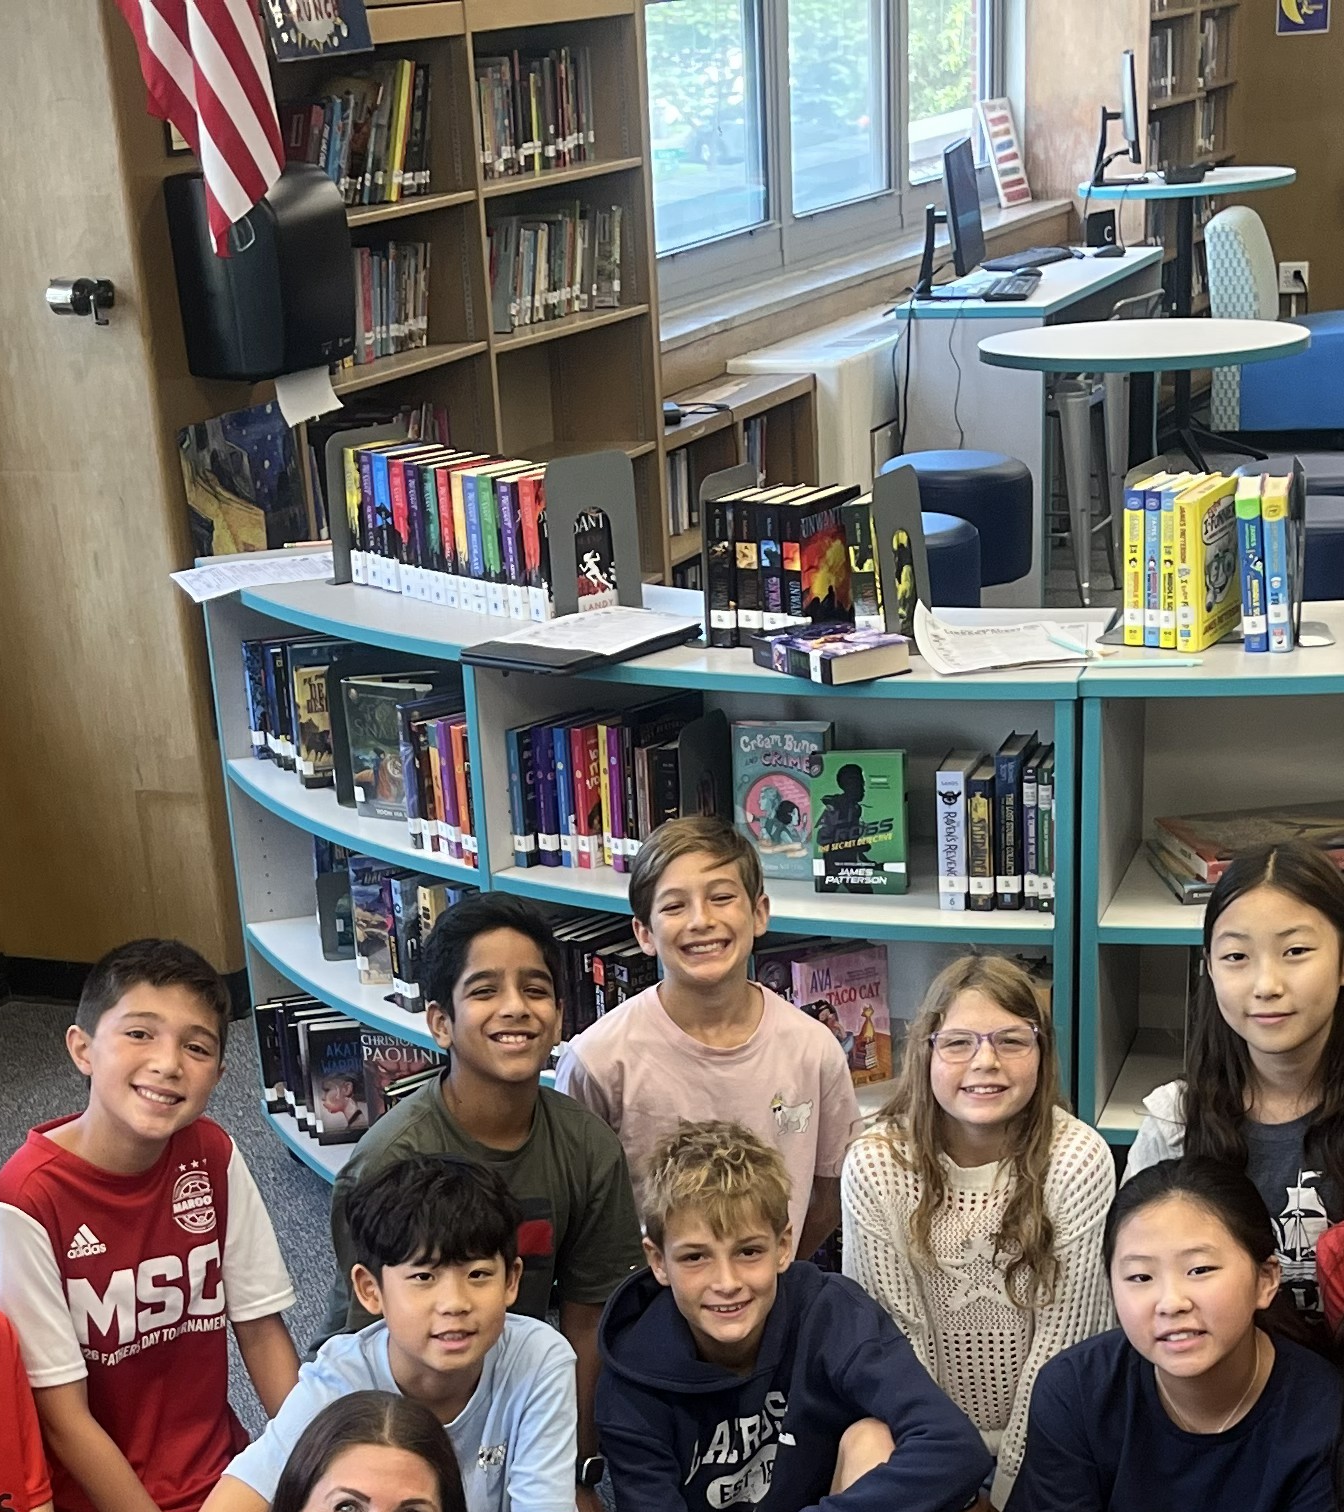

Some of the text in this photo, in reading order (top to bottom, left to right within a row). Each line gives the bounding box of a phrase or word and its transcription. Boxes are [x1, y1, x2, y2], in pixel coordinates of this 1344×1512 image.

[1103, 225, 1113, 242] C
[582, 599, 615, 613] LANDY
[740, 733, 782, 753] Cream
[760, 753, 812, 773] CRIME
[831, 839, 857, 853] SECRET
[857, 833, 895, 847] DETECTIVE
[824, 875, 888, 886] PATTERSON
[837, 867, 874, 877] JAMES
[810, 968, 832, 994] AVA
[826, 981, 881, 1006] TACO CAT
[363, 1046, 441, 1064] PAOLINI
[67, 1243, 107, 1260] adidas
[65, 1242, 226, 1346] MSC
[142, 1332, 160, 1350] DAY
